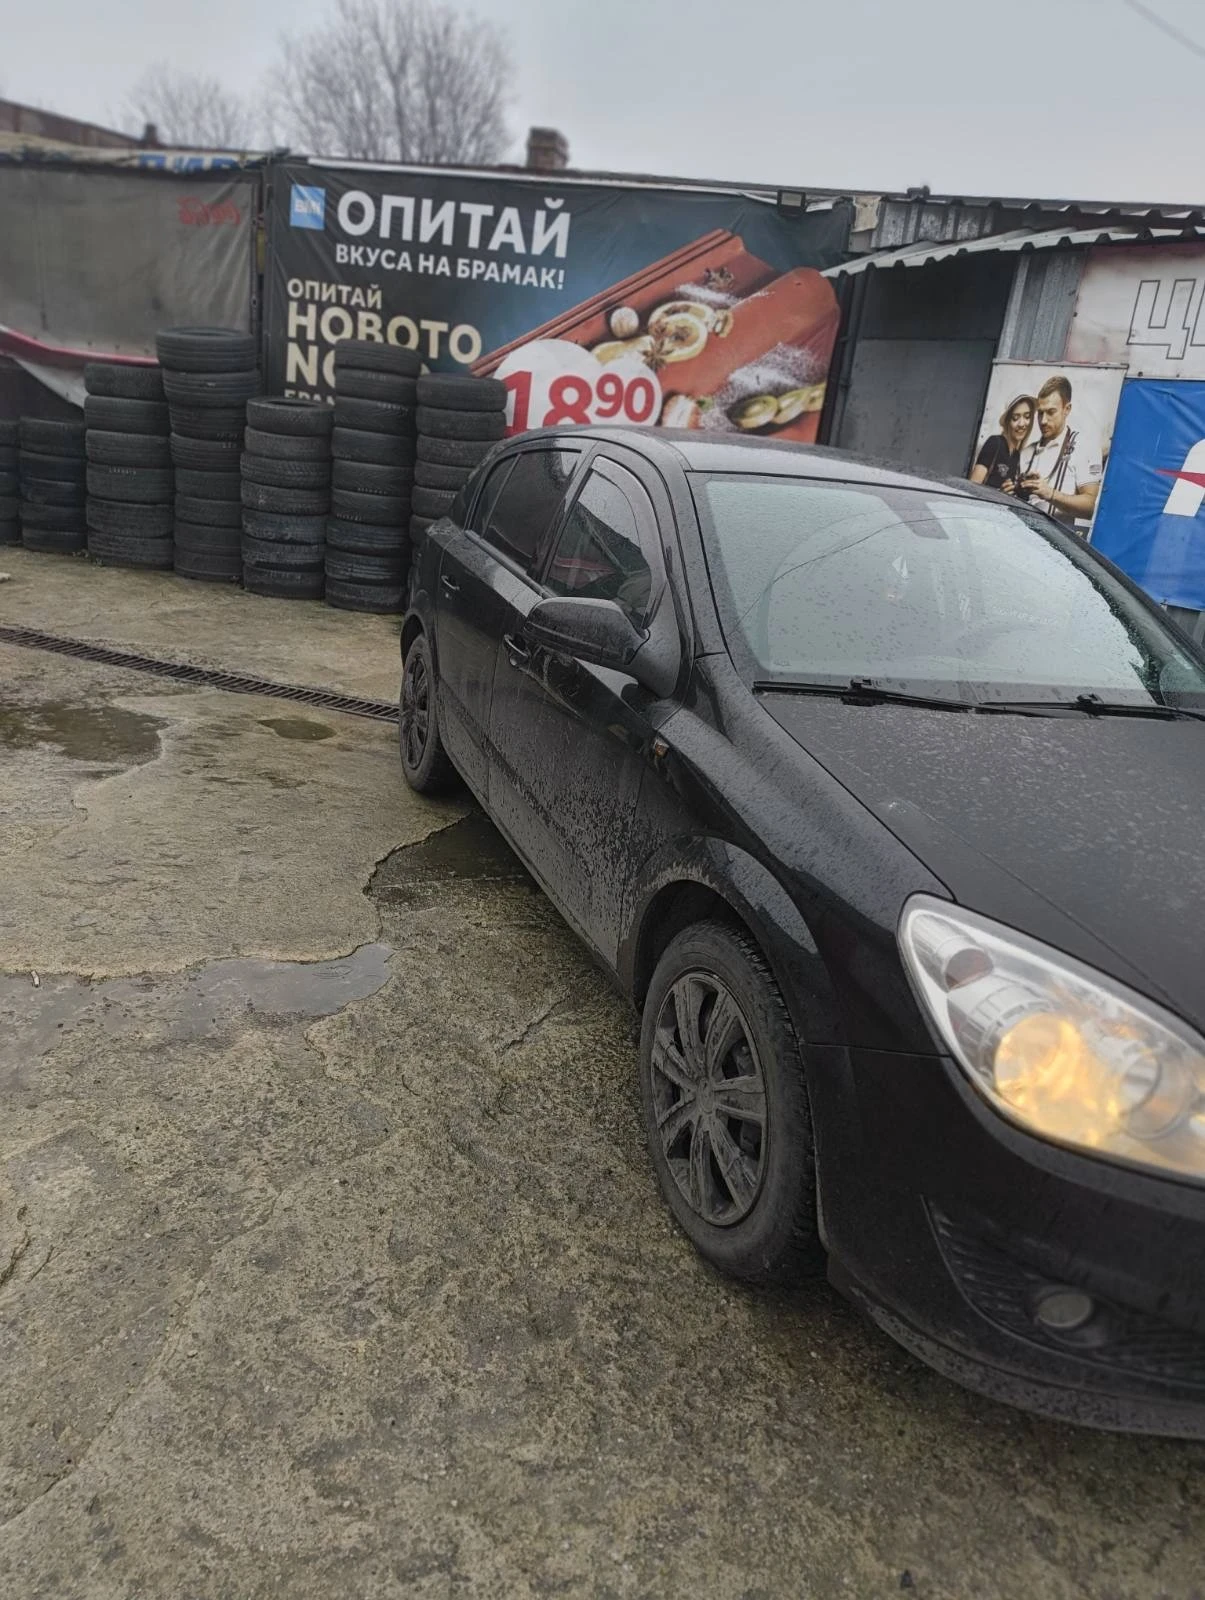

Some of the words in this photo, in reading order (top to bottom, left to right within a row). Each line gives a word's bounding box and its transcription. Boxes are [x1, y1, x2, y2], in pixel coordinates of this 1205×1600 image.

[337, 189, 572, 258] ОПИТАЙ
[287, 278, 382, 310] ОПИТАЙ
[336, 243, 413, 272] ВКУСА
[418, 255, 452, 277] НА
[456, 258, 565, 290] БРАМАК!
[287, 301, 482, 365] НОВОТО
[1126, 278, 1205, 361] Ц
